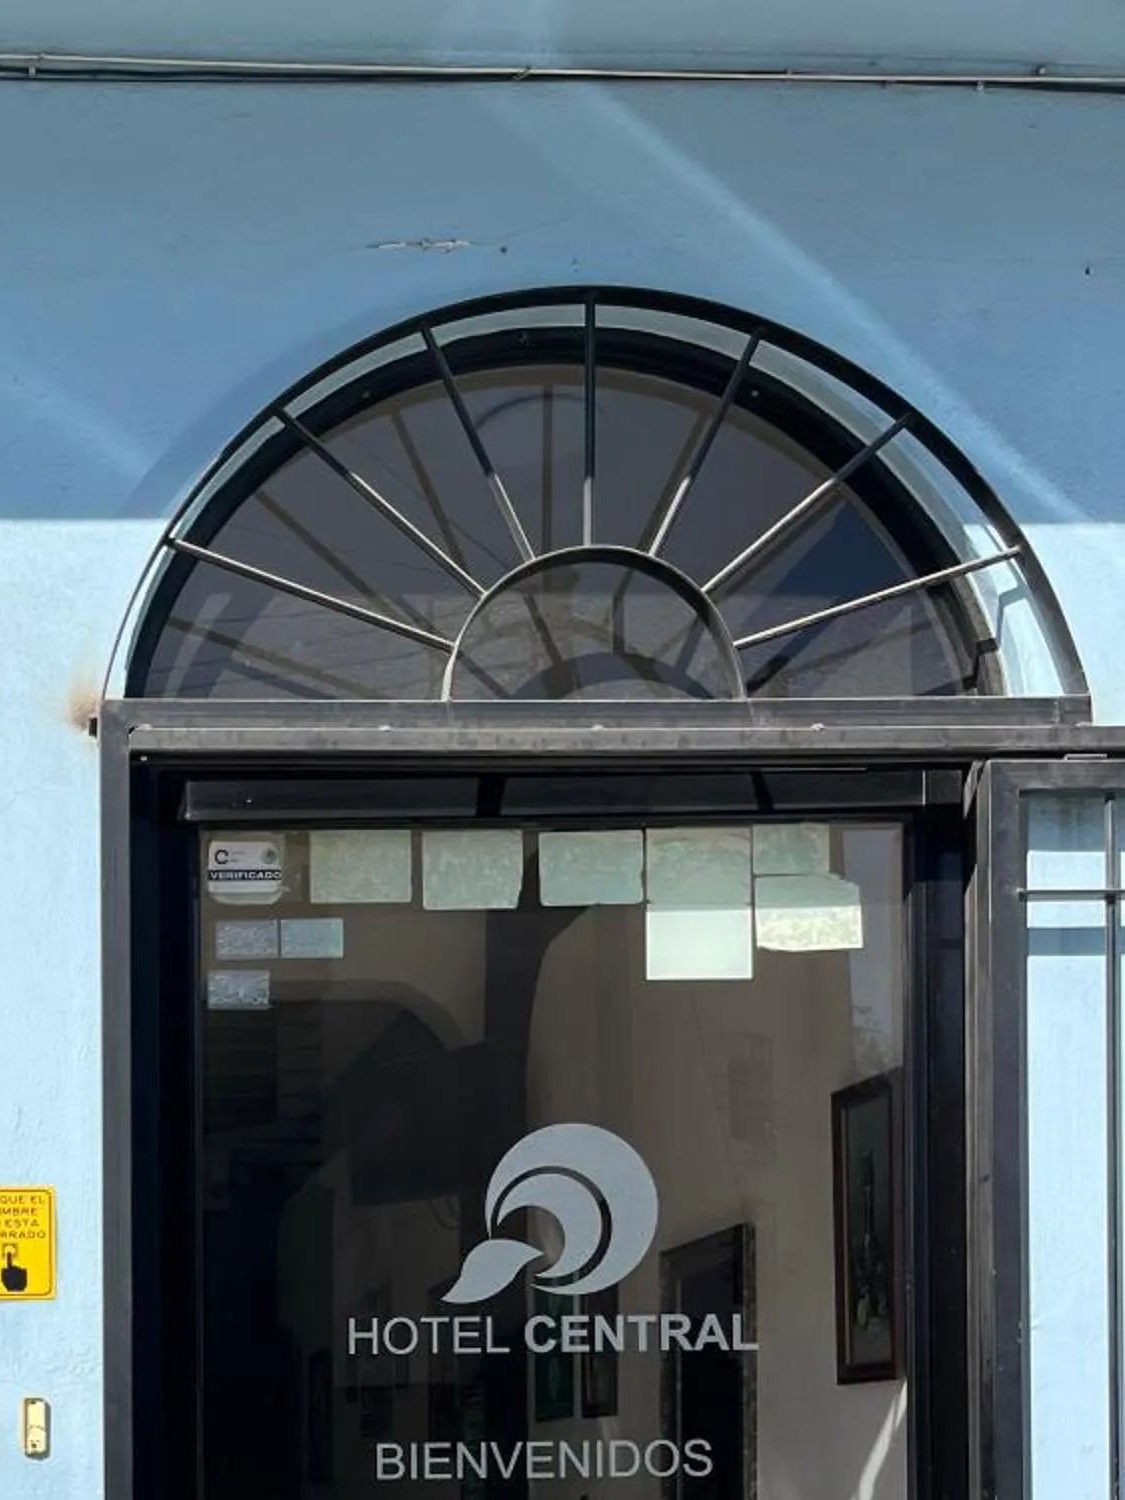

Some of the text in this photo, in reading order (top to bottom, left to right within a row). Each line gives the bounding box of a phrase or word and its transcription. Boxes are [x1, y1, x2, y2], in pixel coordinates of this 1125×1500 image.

[210, 871, 282, 880] VERIFICADO
[30, 1195, 45, 1205] EL
[347, 1313, 759, 1356] HOTEL CENTRAL
[375, 1438, 714, 1481] BIENVENIDOS
